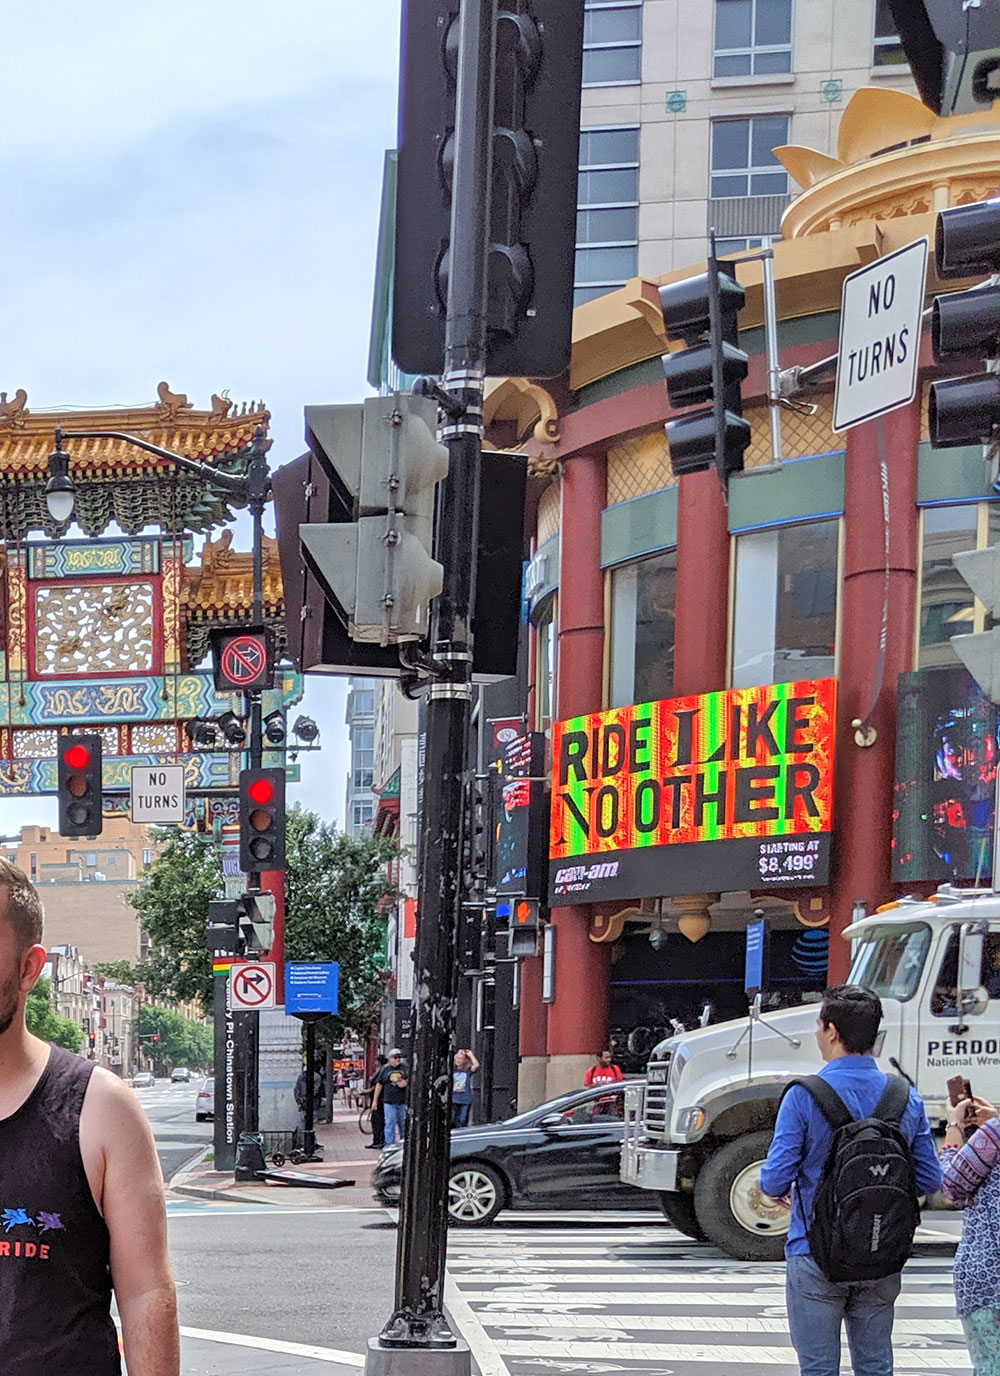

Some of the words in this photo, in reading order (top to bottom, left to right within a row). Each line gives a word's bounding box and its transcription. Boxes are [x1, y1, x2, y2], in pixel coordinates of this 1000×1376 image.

[868, 274, 896, 318] NO
[848, 327, 909, 387] TURNS
[559, 717, 652, 786] RIDE
[672, 696, 816, 768] LIKE
[149, 772, 166, 786] NO
[138, 795, 178, 809] TURNS
[555, 785, 620, 846] NO
[633, 763, 821, 834] OTHER
[760, 841, 805, 854] STARTING
[806, 840, 820, 851] AT
[928, 1039, 1000, 1055] PERDO
[927, 1056, 972, 1067] National
[225, 1103, 234, 1144] Station
